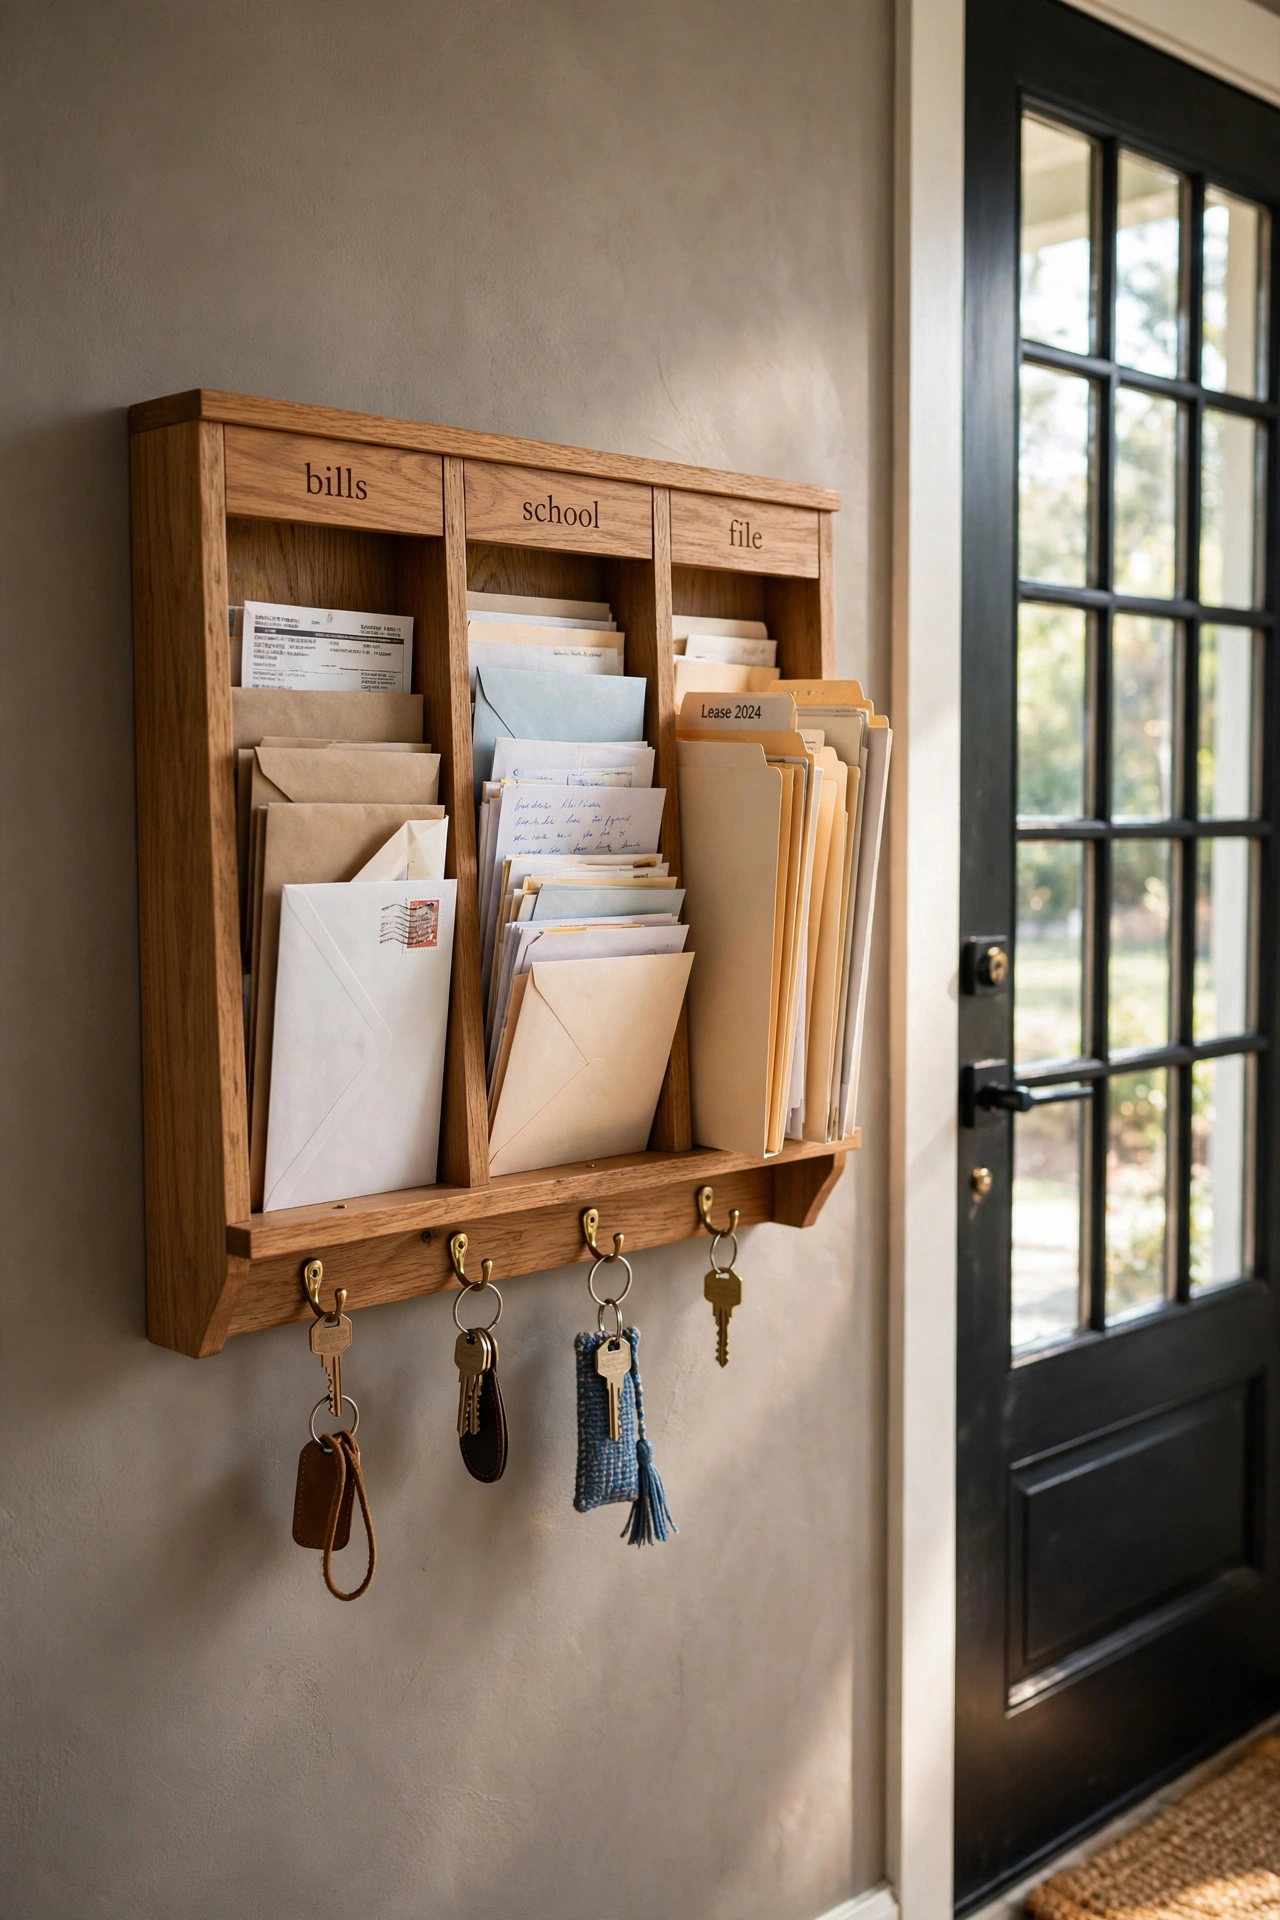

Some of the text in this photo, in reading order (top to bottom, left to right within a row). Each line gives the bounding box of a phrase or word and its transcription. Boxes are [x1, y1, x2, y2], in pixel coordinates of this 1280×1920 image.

[306, 462, 368, 501] bills
[522, 494, 600, 529] school
[728, 519, 763, 549] file
[701, 704, 762, 719] Lease 2024
